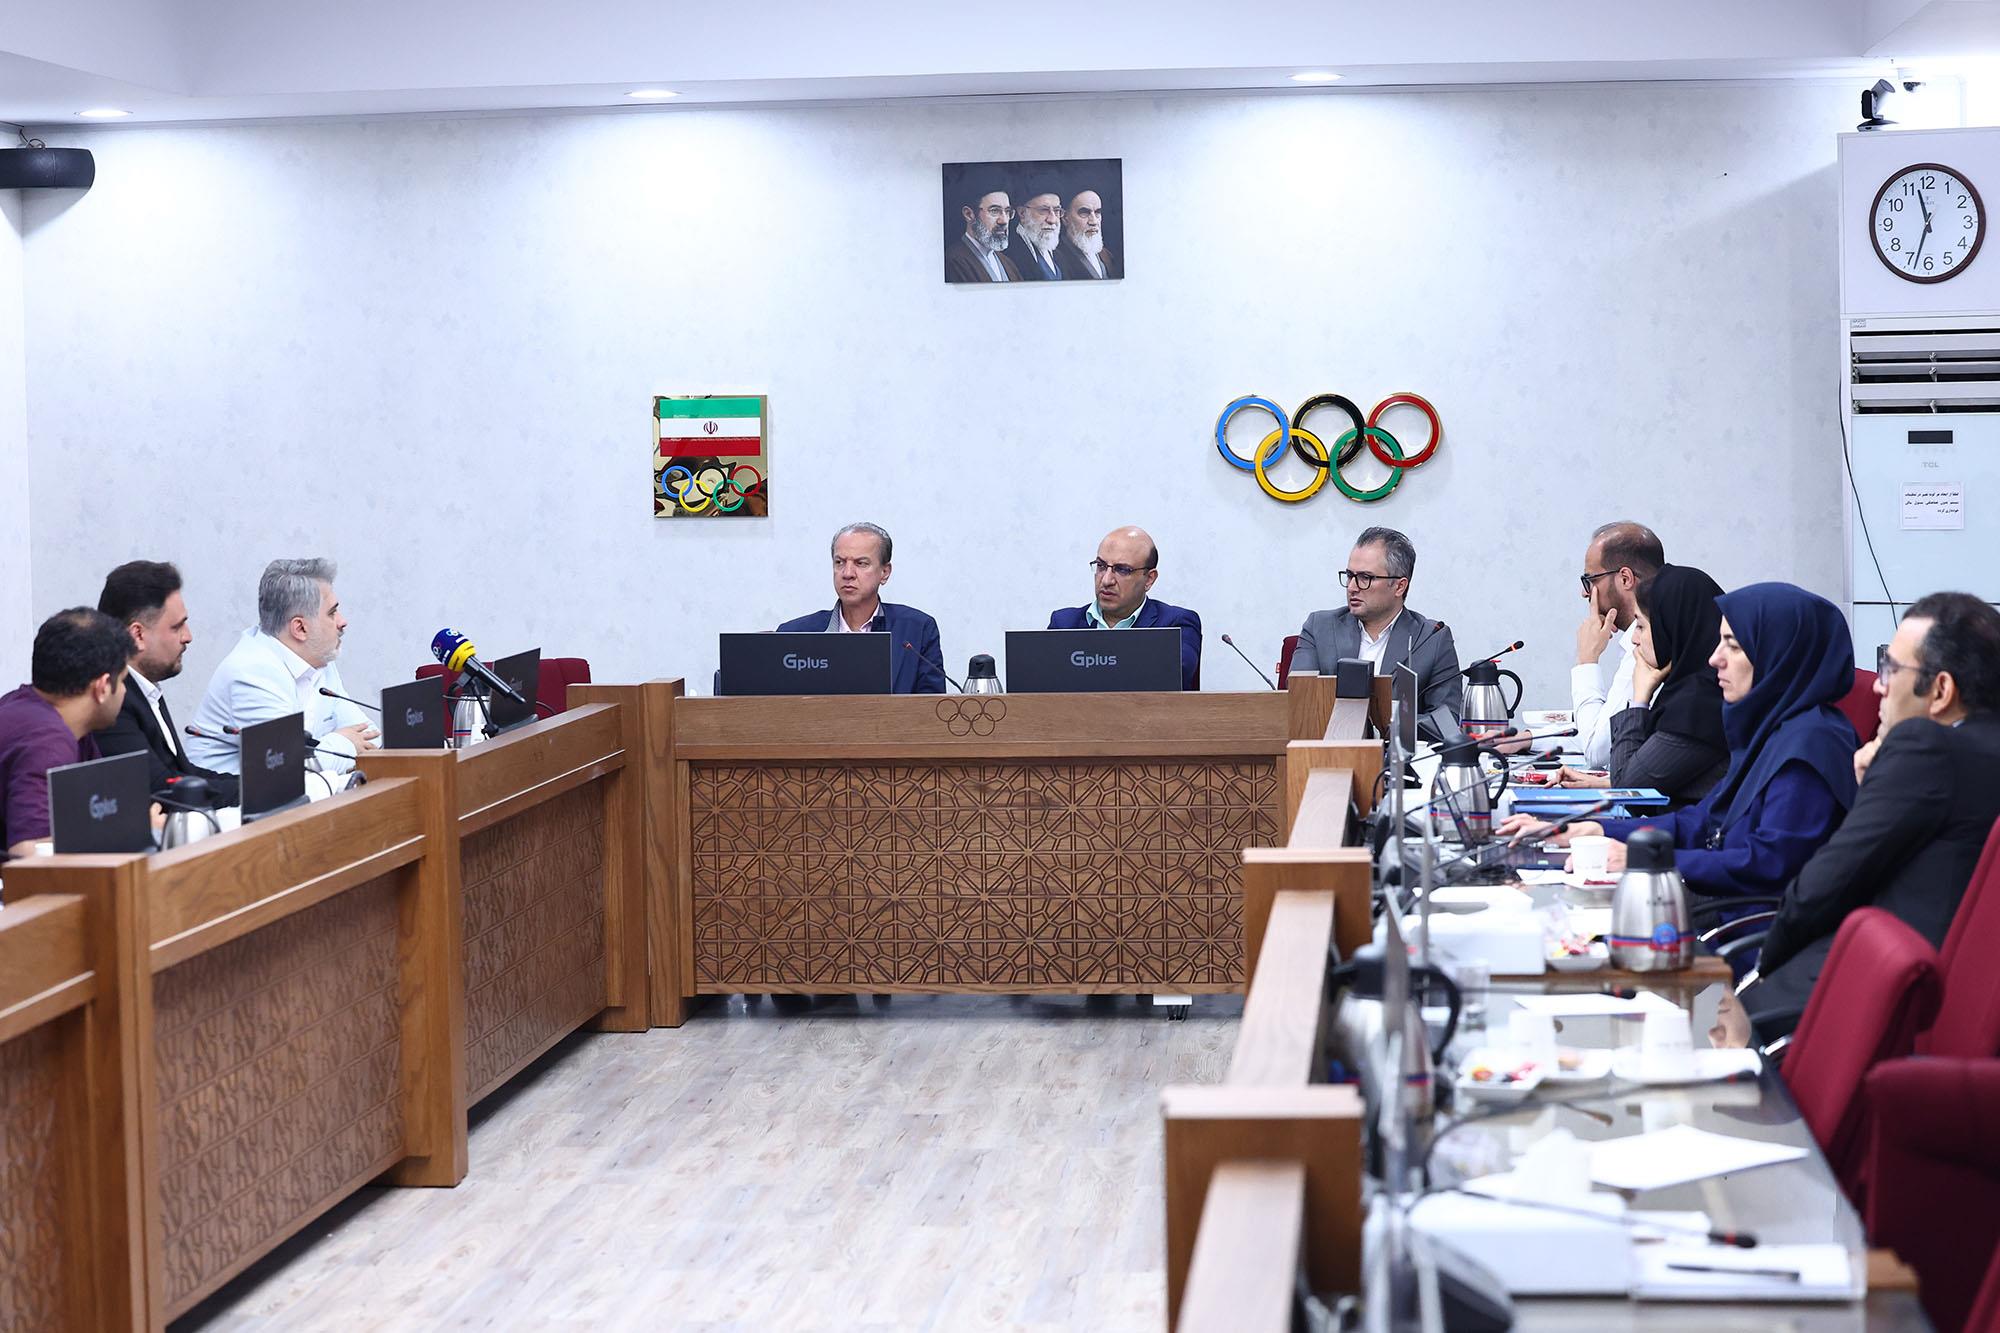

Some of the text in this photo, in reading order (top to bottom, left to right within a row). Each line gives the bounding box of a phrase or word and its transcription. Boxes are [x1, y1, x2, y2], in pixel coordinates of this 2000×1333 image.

[1902, 182, 1915, 196] 11
[1920, 176, 1935, 190] 12
[1944, 181, 1950, 195] 1
[1888, 198, 1904, 212] 10
[1957, 195, 1967, 209] 2
[1883, 217, 1894, 232] 9
[1963, 215, 1974, 230] 3
[1890, 237, 1901, 252] 8
[1957, 236, 1967, 250] 4
[1905, 252, 1915, 266] 7
[1923, 256, 1934, 271] 6
[1943, 252, 1953, 265] 5
[782, 653, 829, 671] Gplus
[1070, 650, 1117, 668] Gplus
